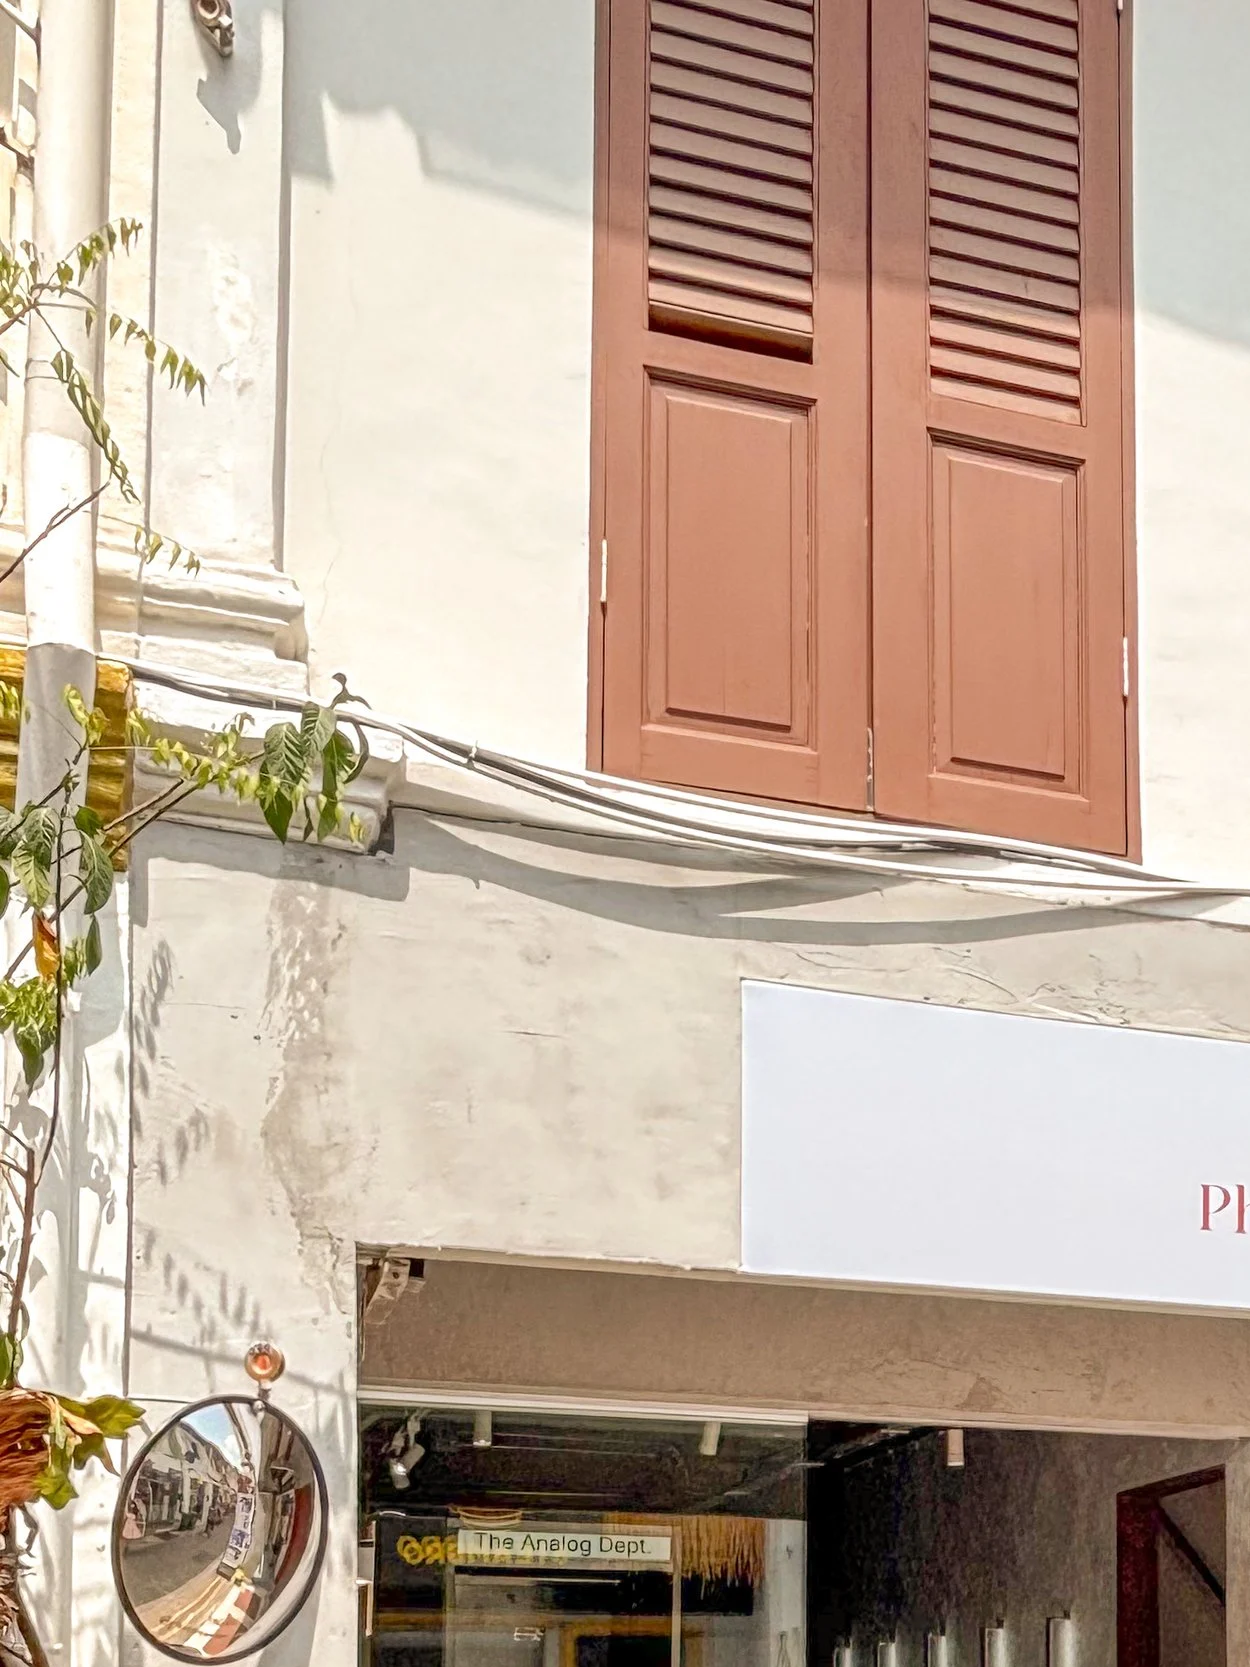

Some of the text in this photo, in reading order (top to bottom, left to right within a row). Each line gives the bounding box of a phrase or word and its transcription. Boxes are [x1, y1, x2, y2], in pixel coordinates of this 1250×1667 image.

[474, 1532, 514, 1550] The
[521, 1534, 592, 1557] Analog
[600, 1536, 651, 1558] Dept.
